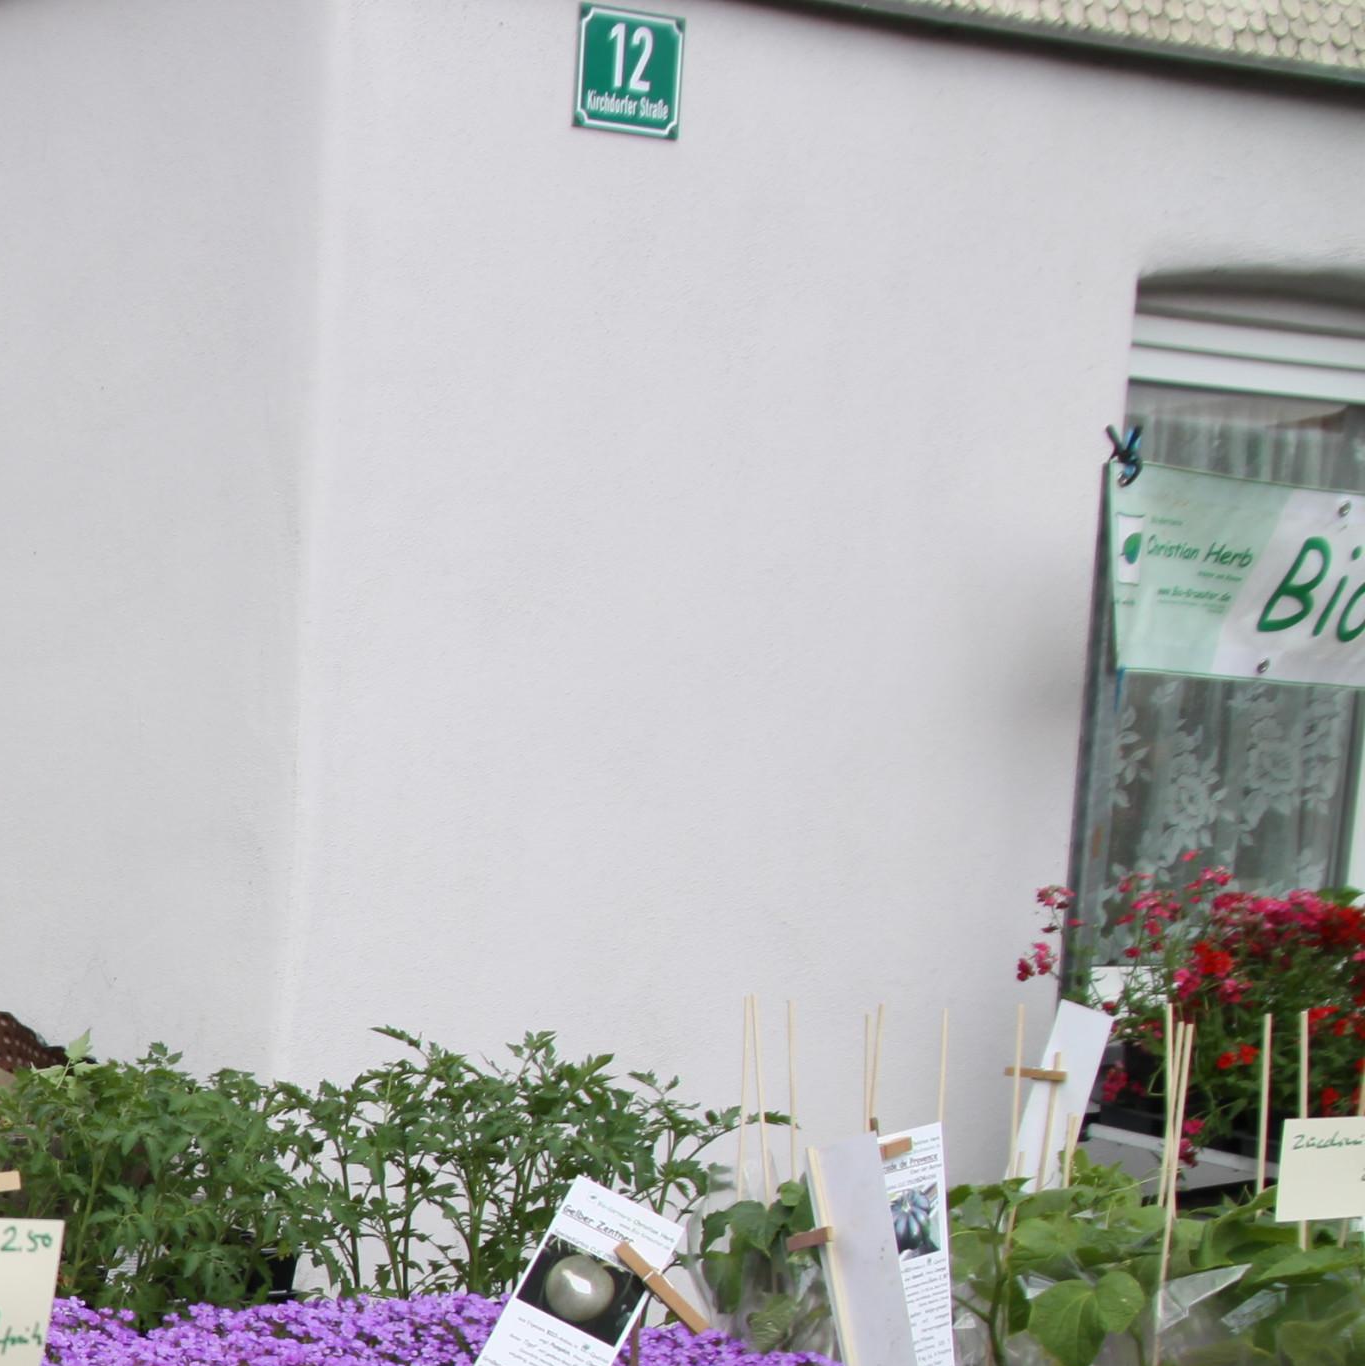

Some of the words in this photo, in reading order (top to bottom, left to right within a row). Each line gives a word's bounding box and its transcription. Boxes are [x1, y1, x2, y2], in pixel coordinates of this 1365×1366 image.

[610, 22, 653, 92] 12
[587, 90, 637, 116] Kirchdorfer
[639, 96, 669, 120] Straße
[1147, 534, 1200, 560] Christian
[1203, 542, 1253, 568] Herb
[562, 1203, 595, 1225] Gelber
[595, 1220, 636, 1244] Zentner
